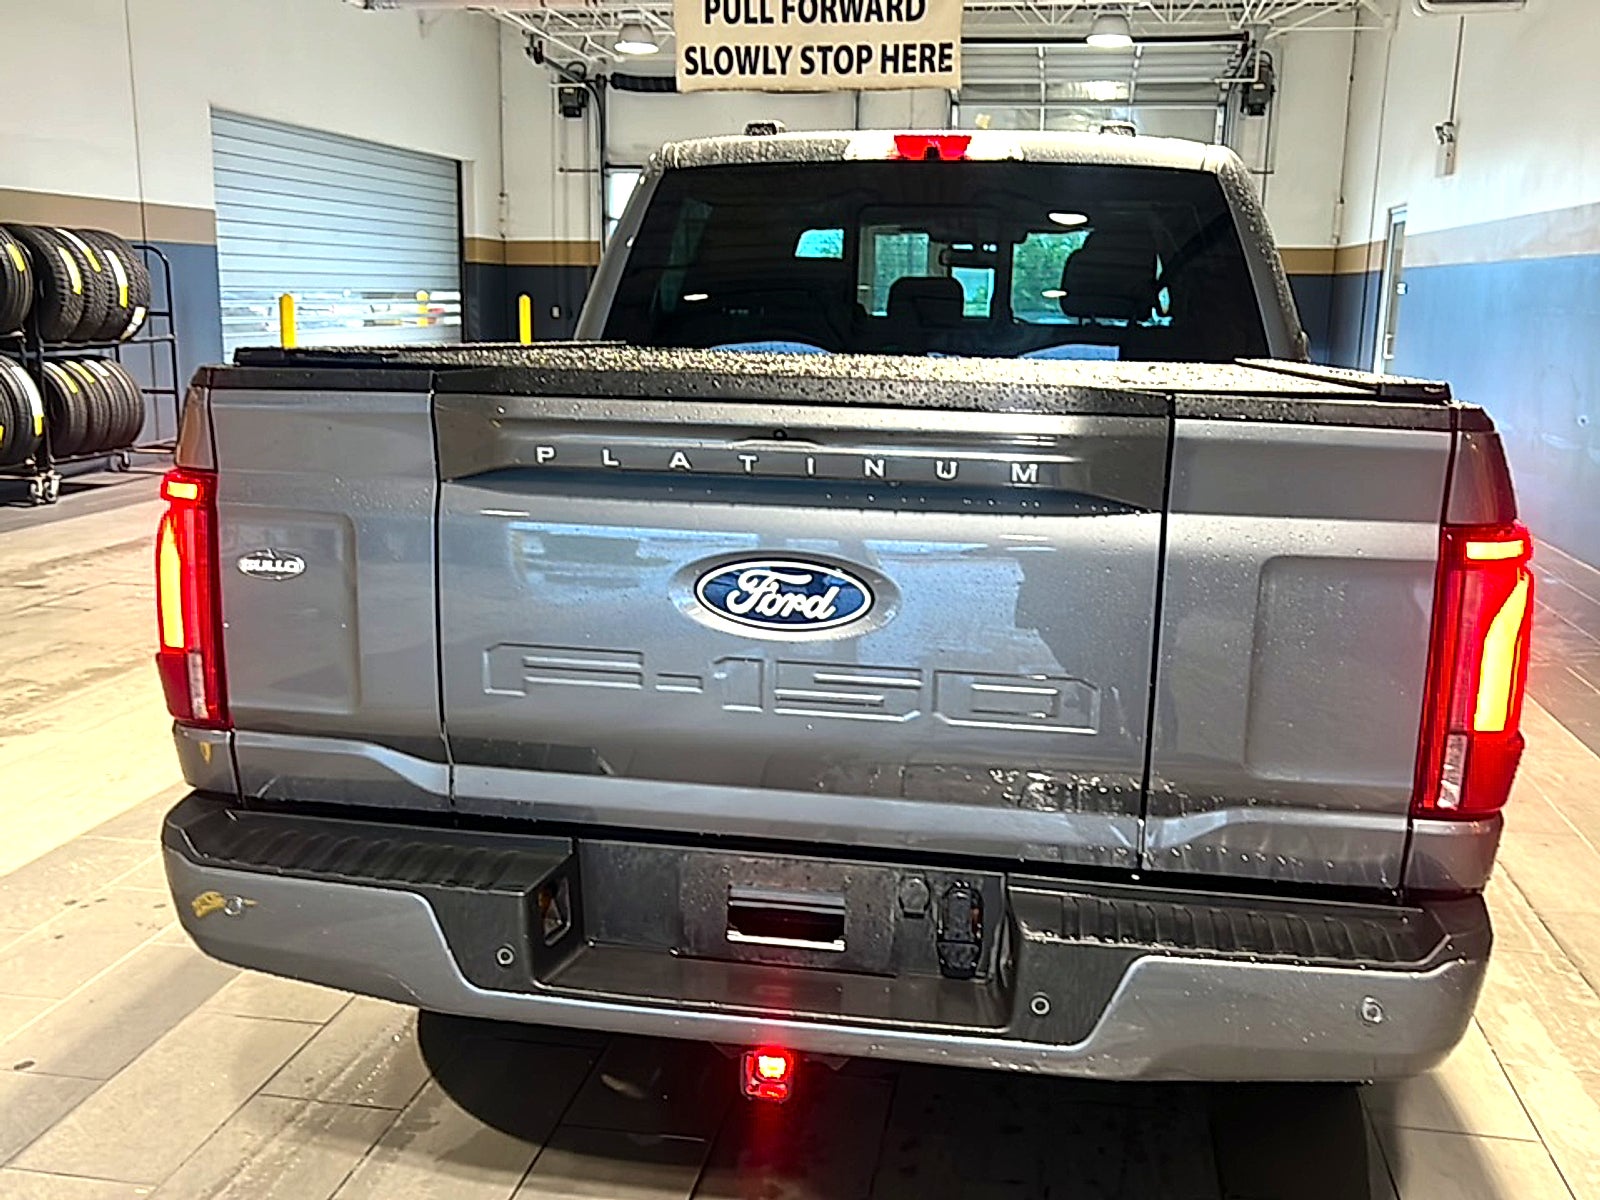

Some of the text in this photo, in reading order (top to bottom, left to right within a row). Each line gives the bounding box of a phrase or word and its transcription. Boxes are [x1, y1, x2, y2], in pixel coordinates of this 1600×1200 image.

[704, 0, 926, 25] PULL FORWARD
[684, 42, 953, 76] SLOWLY STOP HERE
[535, 445, 1040, 485] PLATINUM
[726, 569, 841, 620] Ford
[483, 642, 1099, 736] F-150
